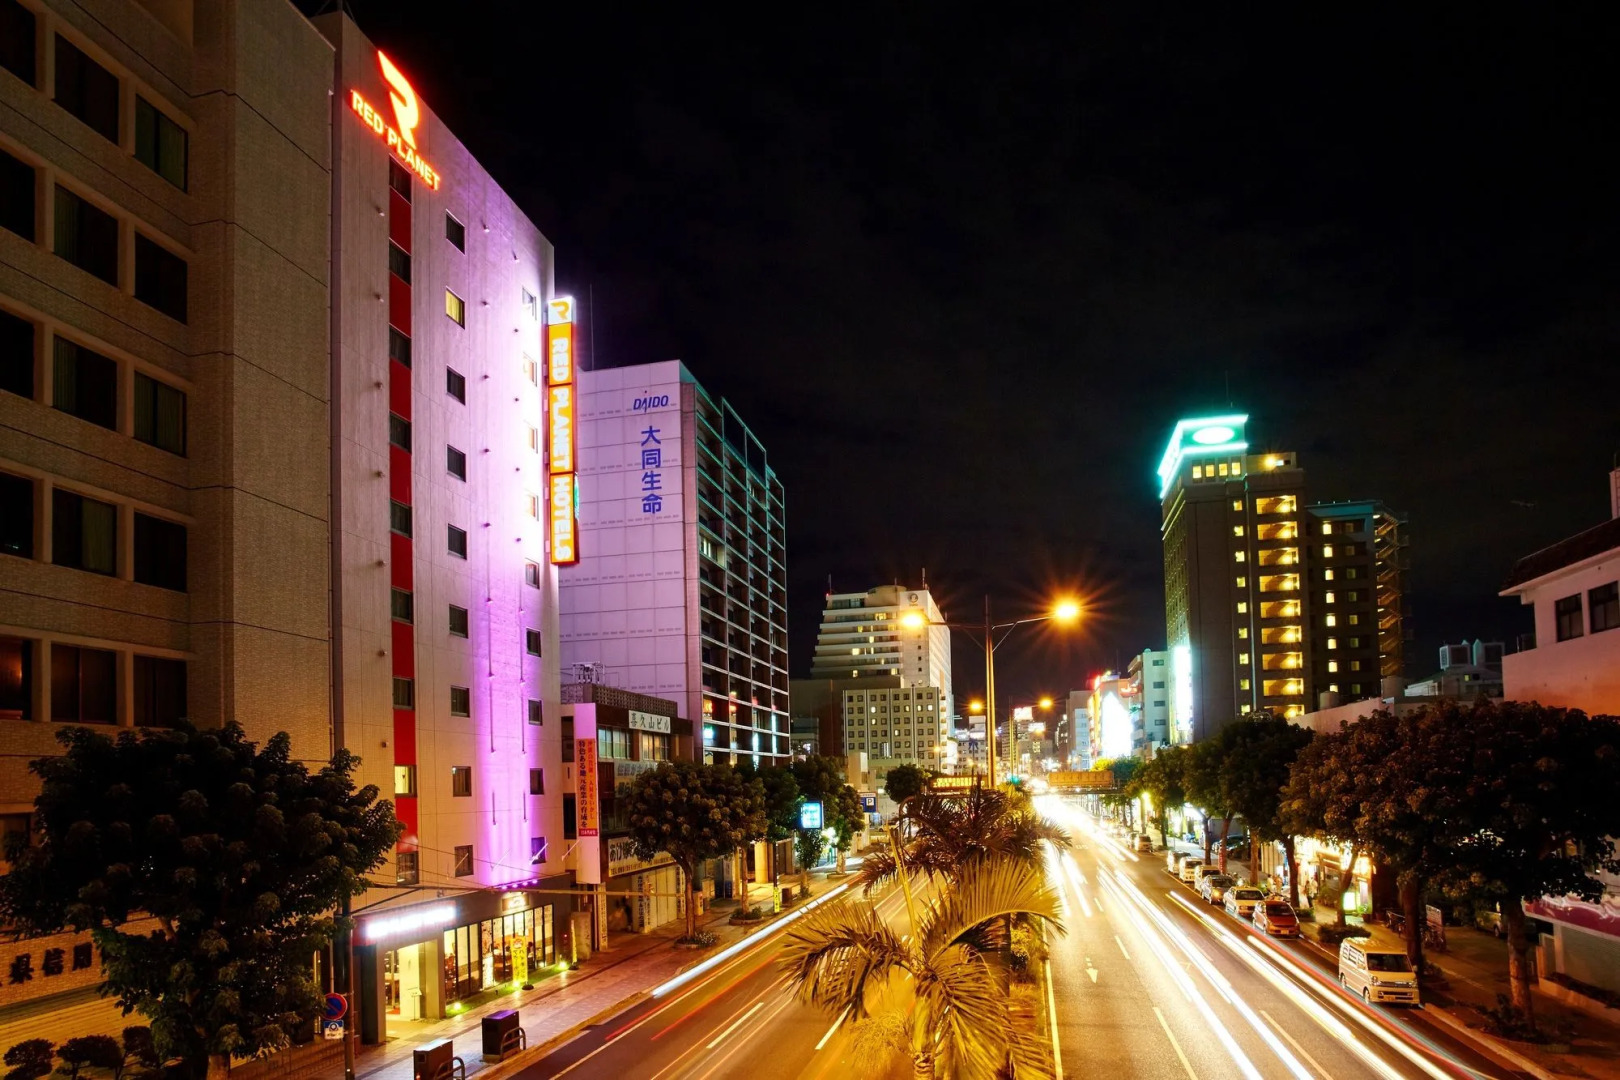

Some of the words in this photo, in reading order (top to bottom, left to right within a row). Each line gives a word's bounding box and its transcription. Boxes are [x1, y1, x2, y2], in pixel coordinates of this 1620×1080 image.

[350, 89, 385, 135] RED
[386, 126, 442, 192] PLANET
[551, 337, 570, 382] RED
[551, 387, 571, 470] PLANET
[633, 394, 669, 412] DAIDO
[640, 426, 662, 514] 大同生命
[553, 476, 573, 561] HOTELS
